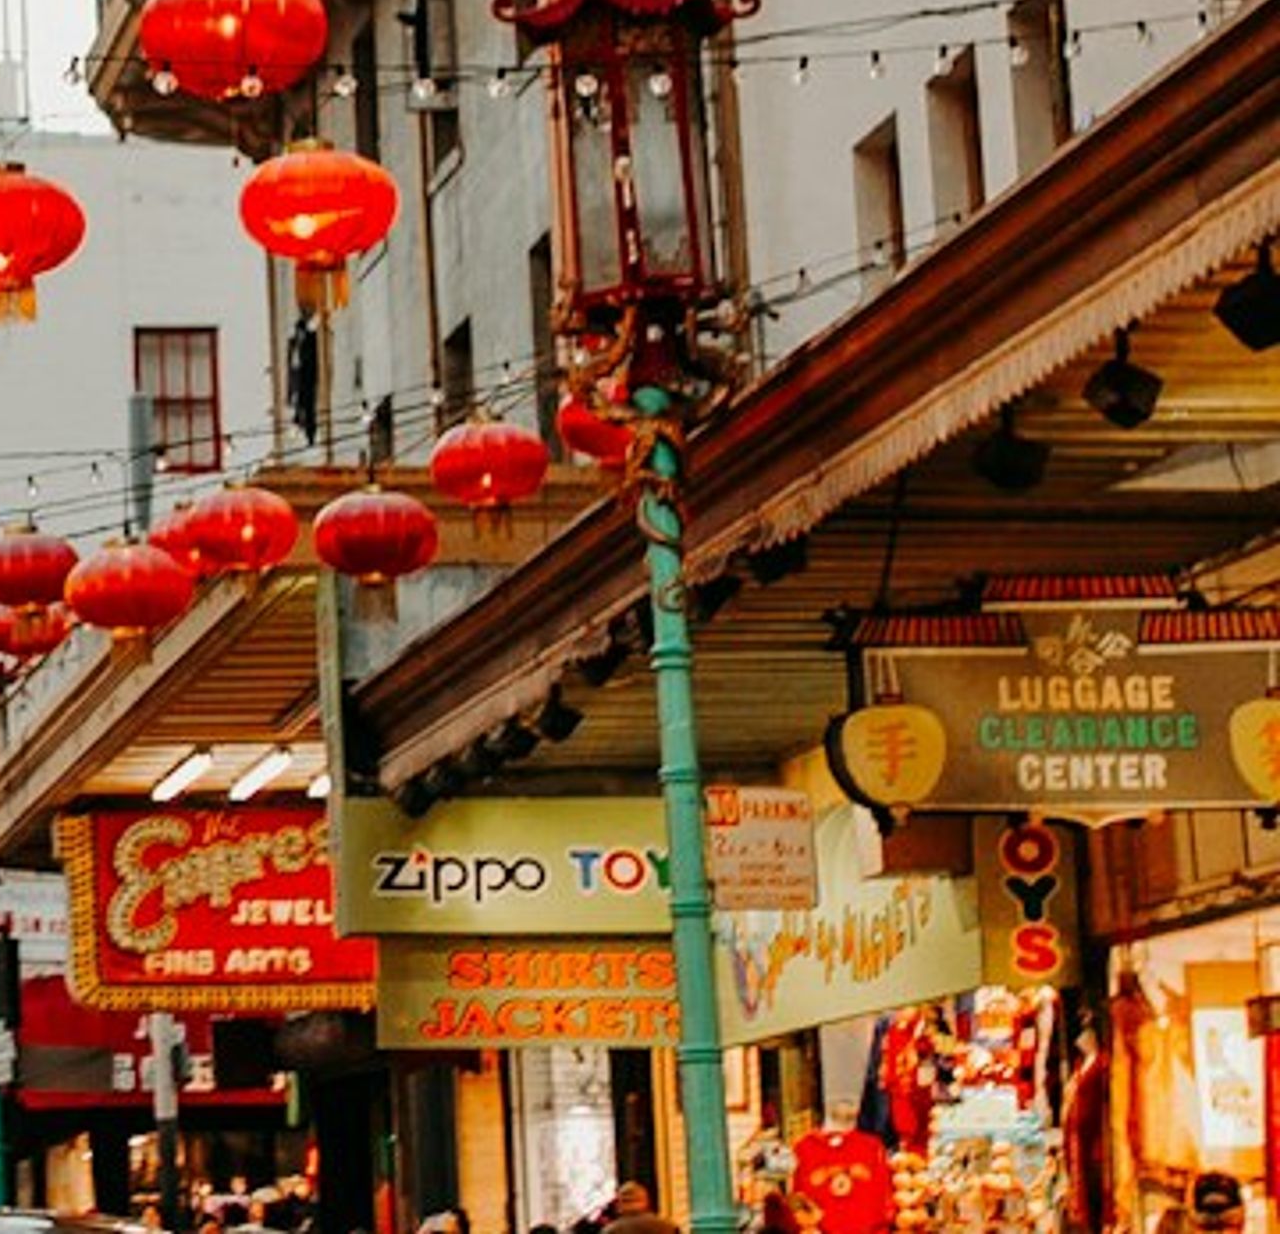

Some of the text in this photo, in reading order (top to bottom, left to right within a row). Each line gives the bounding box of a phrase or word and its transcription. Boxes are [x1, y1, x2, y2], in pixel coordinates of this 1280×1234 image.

[998, 675, 1176, 711] LUGGAGE
[979, 716, 1200, 749] CLEARANCE
[1017, 754, 1169, 791] CENTER
[375, 850, 546, 903] zippo
[144, 949, 312, 975] FINE ARTS
[448, 950, 677, 990] SHIRTS
